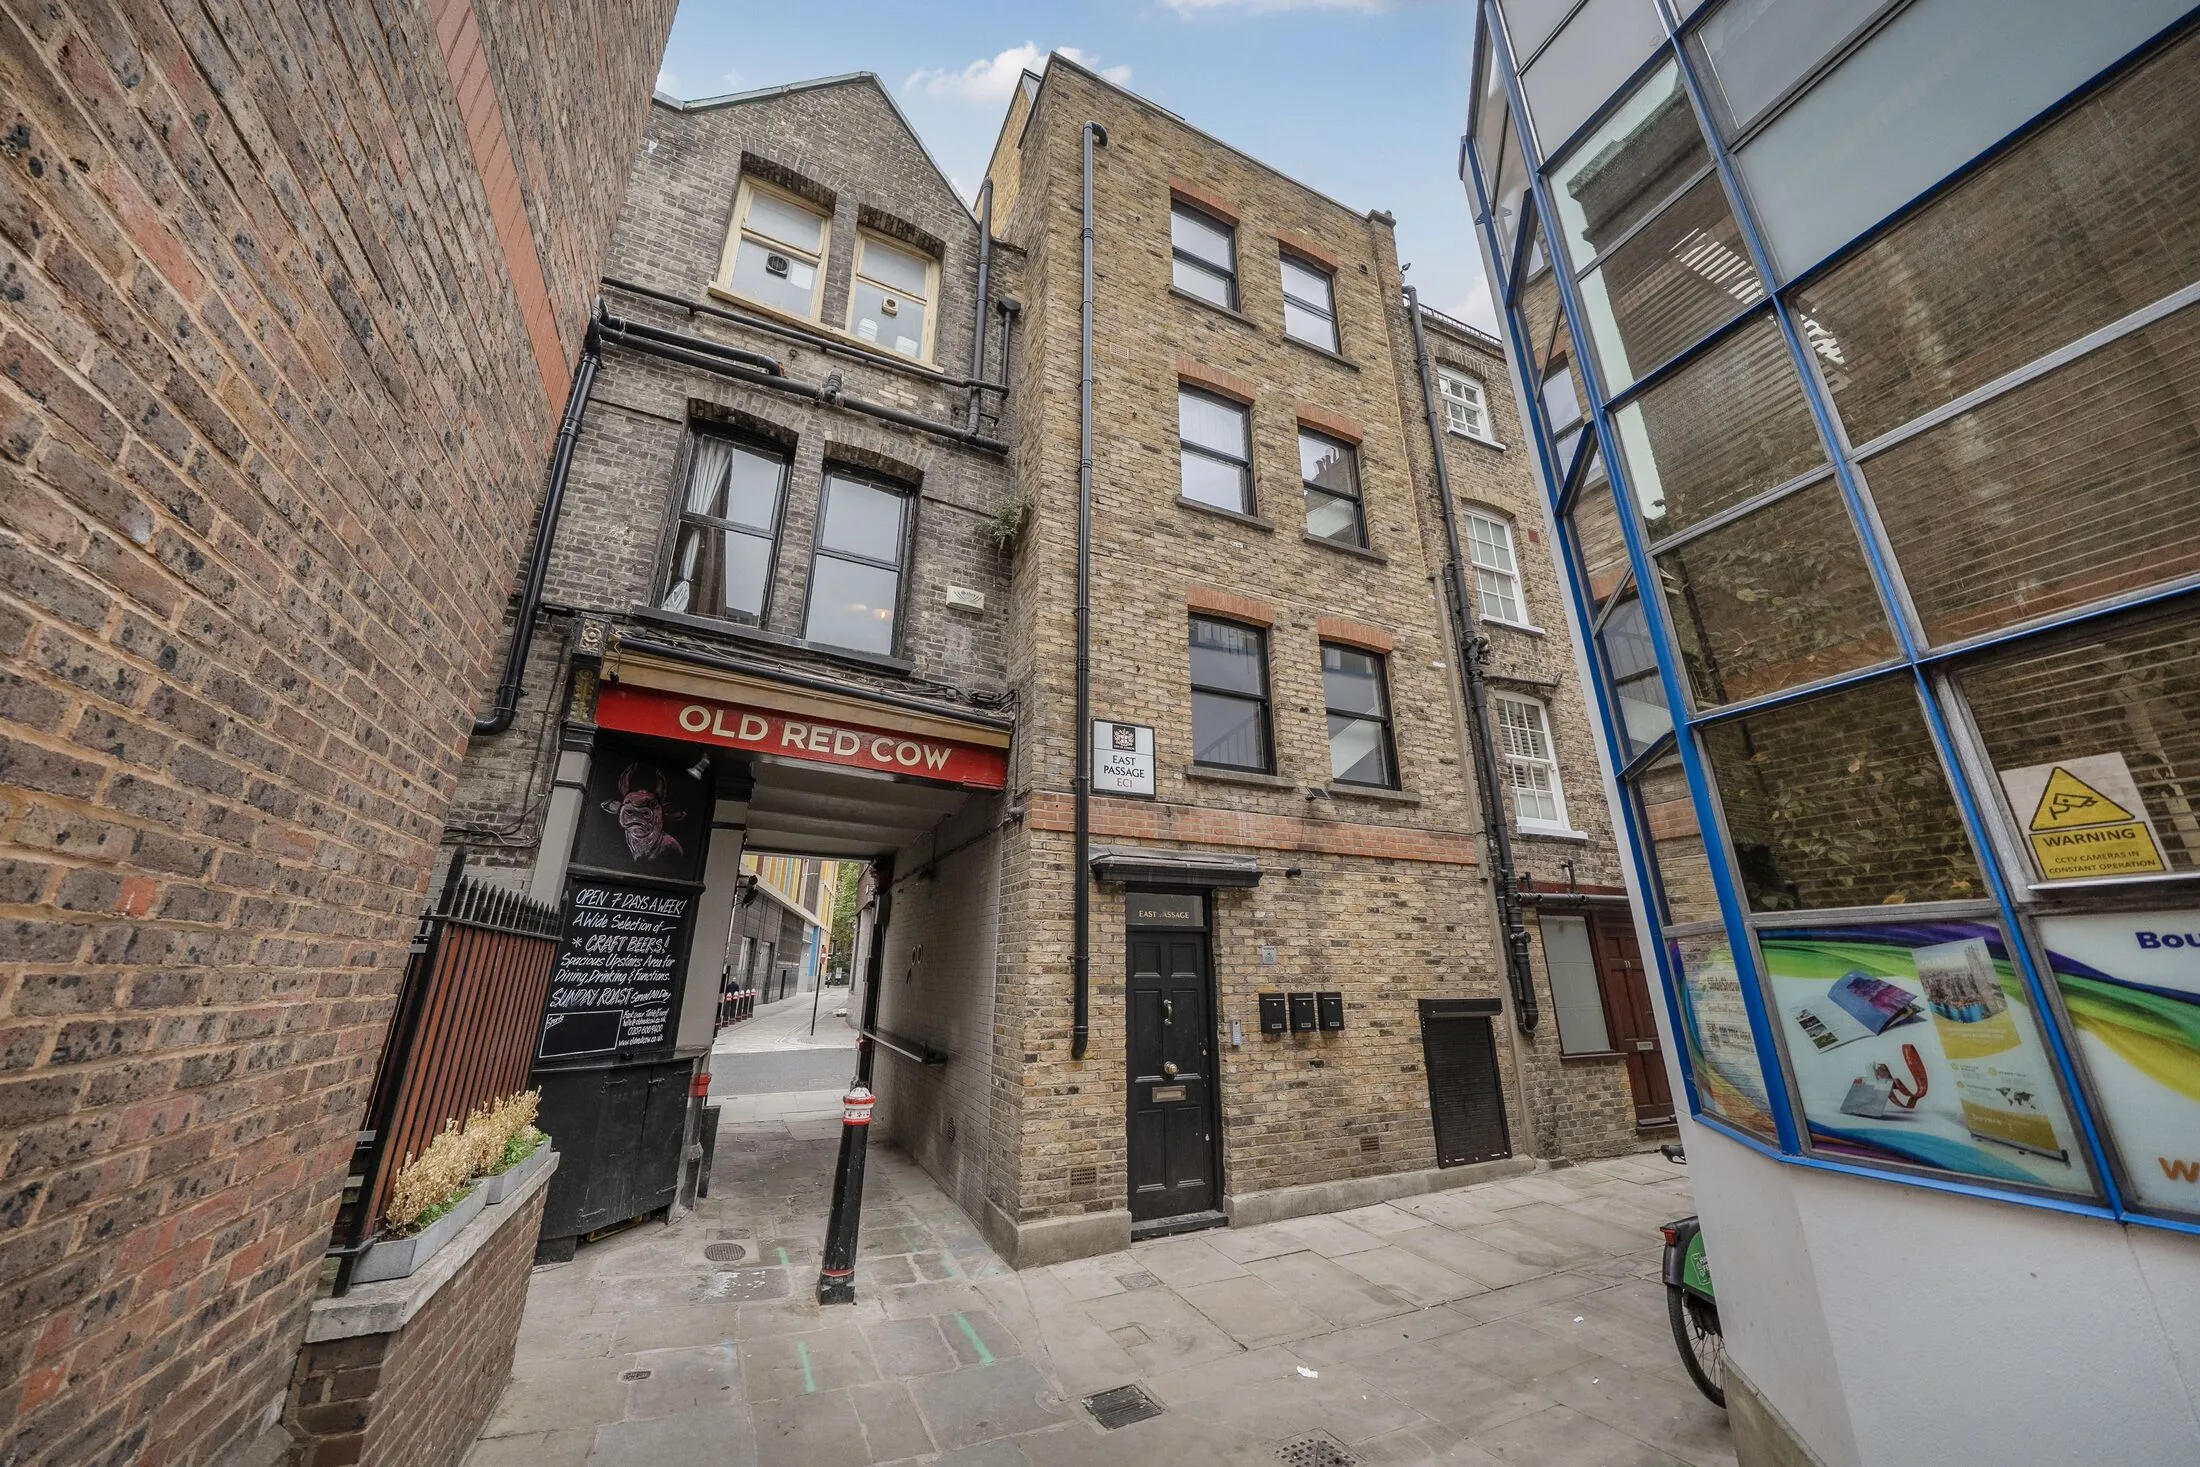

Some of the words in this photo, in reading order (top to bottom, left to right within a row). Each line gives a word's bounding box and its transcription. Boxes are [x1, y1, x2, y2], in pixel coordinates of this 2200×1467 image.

[679, 705, 769, 741] OLD
[781, 721, 861, 756] RED
[870, 737, 952, 772] COW
[1112, 755, 1136, 766] EAST
[1103, 765, 1145, 778] PASSAGE
[2042, 828, 2136, 848] WARNING
[2055, 855, 2078, 864] CCTV
[2080, 851, 2126, 862] CAMERAS
[2128, 850, 2140, 858] IN
[2049, 864, 2098, 874] CONSTANT
[2099, 859, 2156, 871] OPERATION
[575, 888, 610, 906] OPEN
[612, 893, 623, 907] 7
[622, 894, 650, 910] DAYS
[585, 911, 608, 929] Wide
[611, 914, 653, 931] Selection
[1138, 910, 1157, 918] EAST
[1159, 910, 1190, 919] ASSAGE
[585, 934, 629, 953] CRAFT
[628, 935, 671, 954] BEERS!
[561, 952, 606, 968] Spacious
[605, 953, 643, 969] Upstairs
[643, 955, 663, 968] Area
[662, 954, 676, 968] for
[550, 987, 601, 1007] SUNDAY
[597, 987, 635, 1006] ROAST
